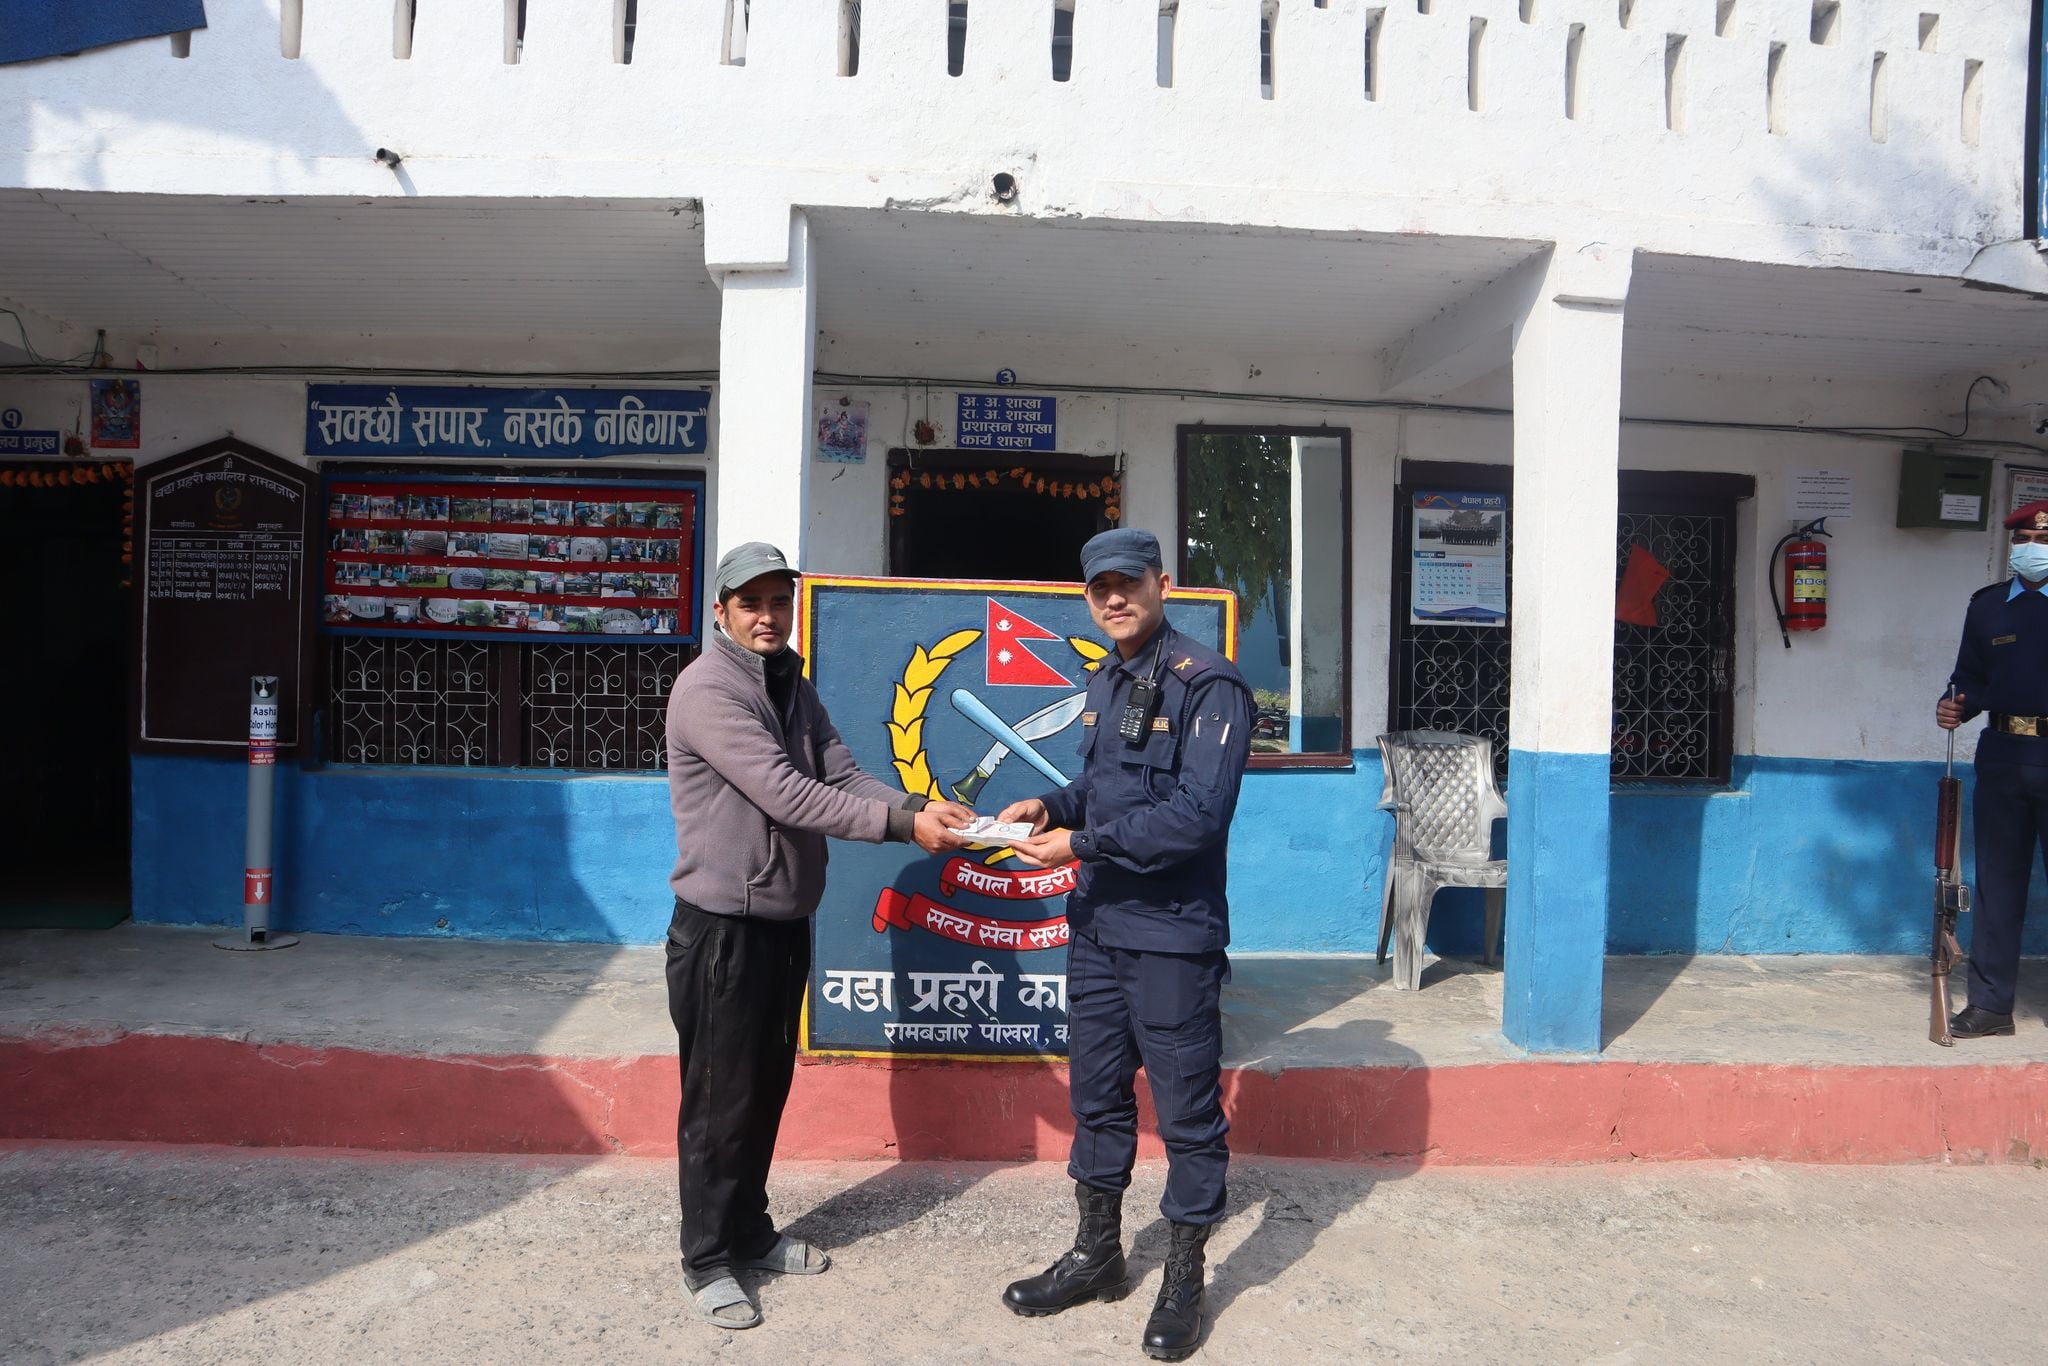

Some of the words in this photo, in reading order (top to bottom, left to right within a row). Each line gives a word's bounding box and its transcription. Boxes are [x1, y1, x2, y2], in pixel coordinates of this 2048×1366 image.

[1006, 398, 1042, 409] शाखा
[504, 396, 586, 448] नसके
[1006, 410, 1042, 422] शाखा
[962, 421, 1013, 433] प्रशासन
[1017, 423, 1053, 434] शाखा
[997, 436, 1033, 447] शाखा
[253, 706, 277, 716] Aasha
[957, 863, 1012, 895] नेपाल
[1018, 866, 1074, 895] प्रहरी
[926, 907, 975, 939] सत्य
[978, 920, 1024, 946] सेवा
[822, 970, 896, 1013] वडा
[907, 960, 1005, 1017] प्रहरी
[1018, 974, 1067, 1013] का
[883, 1023, 972, 1044] रामबजार
